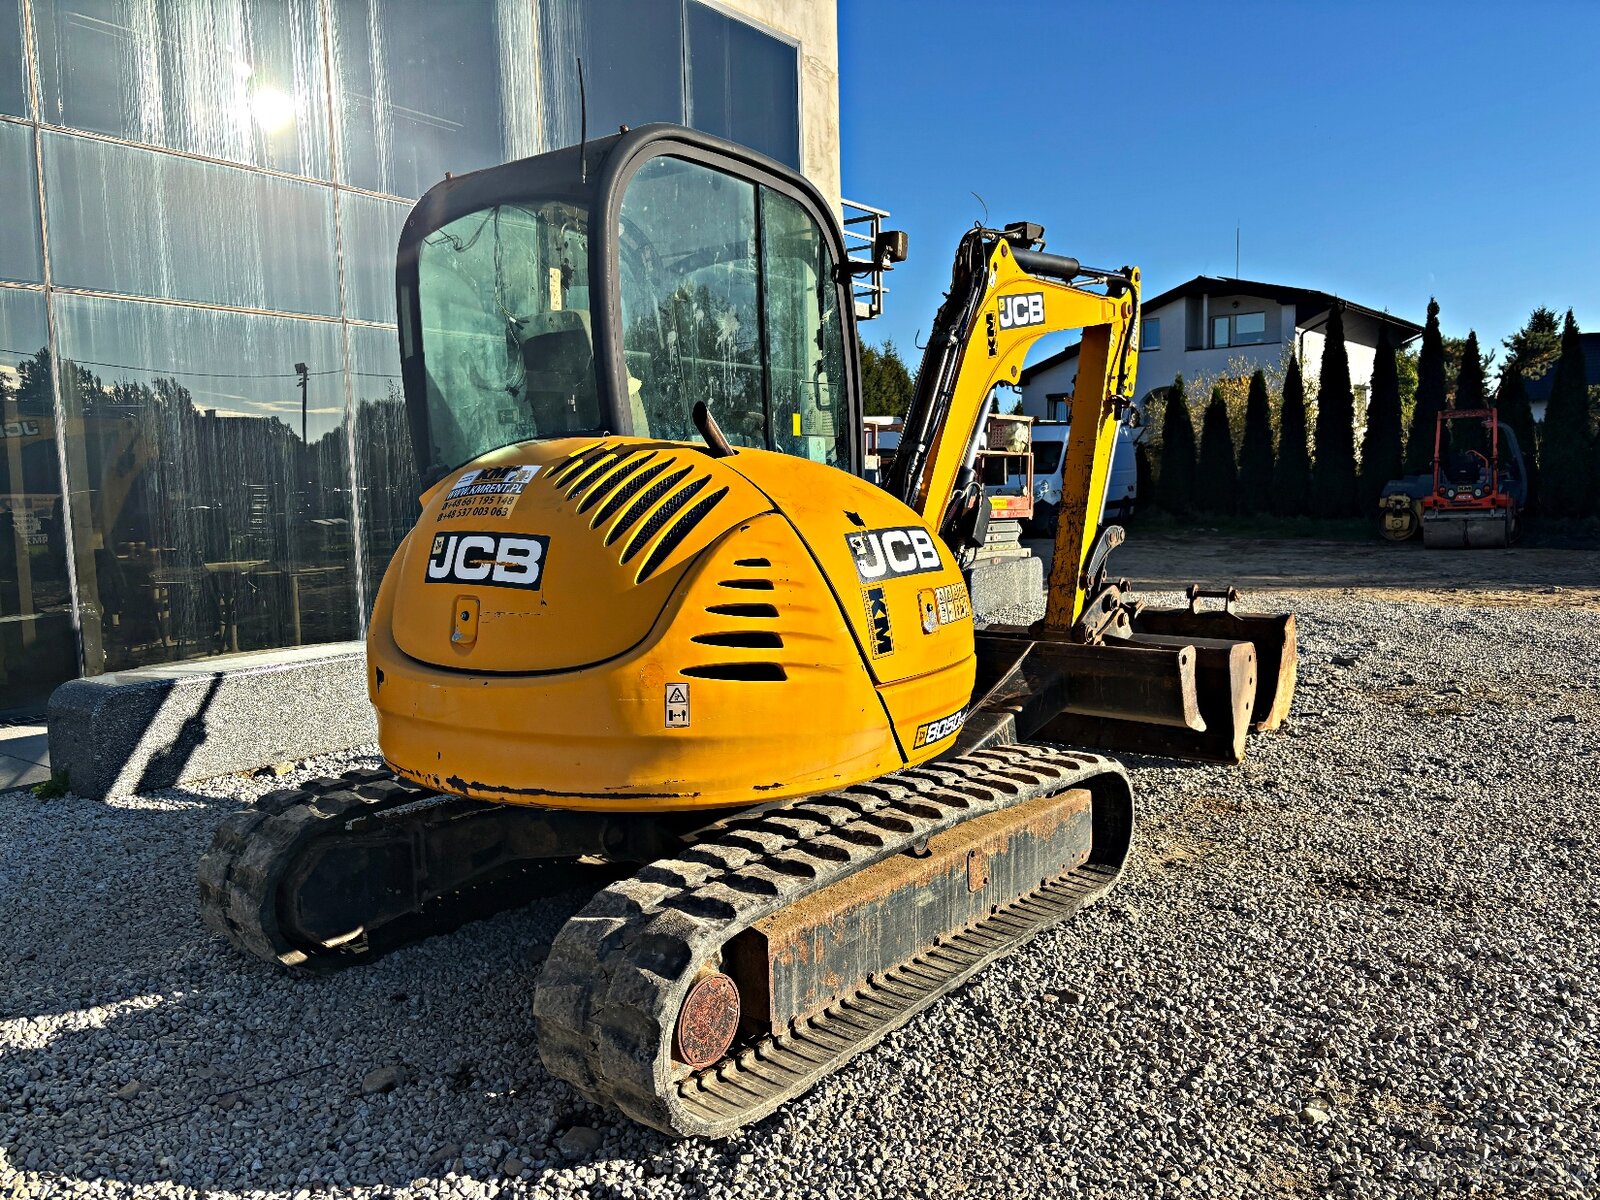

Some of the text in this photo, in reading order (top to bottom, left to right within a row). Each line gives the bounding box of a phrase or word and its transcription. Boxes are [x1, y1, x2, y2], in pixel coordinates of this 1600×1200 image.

[999, 294, 1044, 327] JCB
[985, 312, 997, 357] KM
[447, 483, 523, 500] WWW.KMRENT.PL
[461, 497, 478, 506] 661
[478, 496, 495, 505] 195
[496, 496, 514, 505] 148
[456, 508, 472, 518] 537
[472, 507, 489, 516] 003
[490, 506, 509, 517] 063
[428, 536, 543, 584] JCB
[856, 530, 941, 578] JCB
[867, 588, 893, 655] KM
